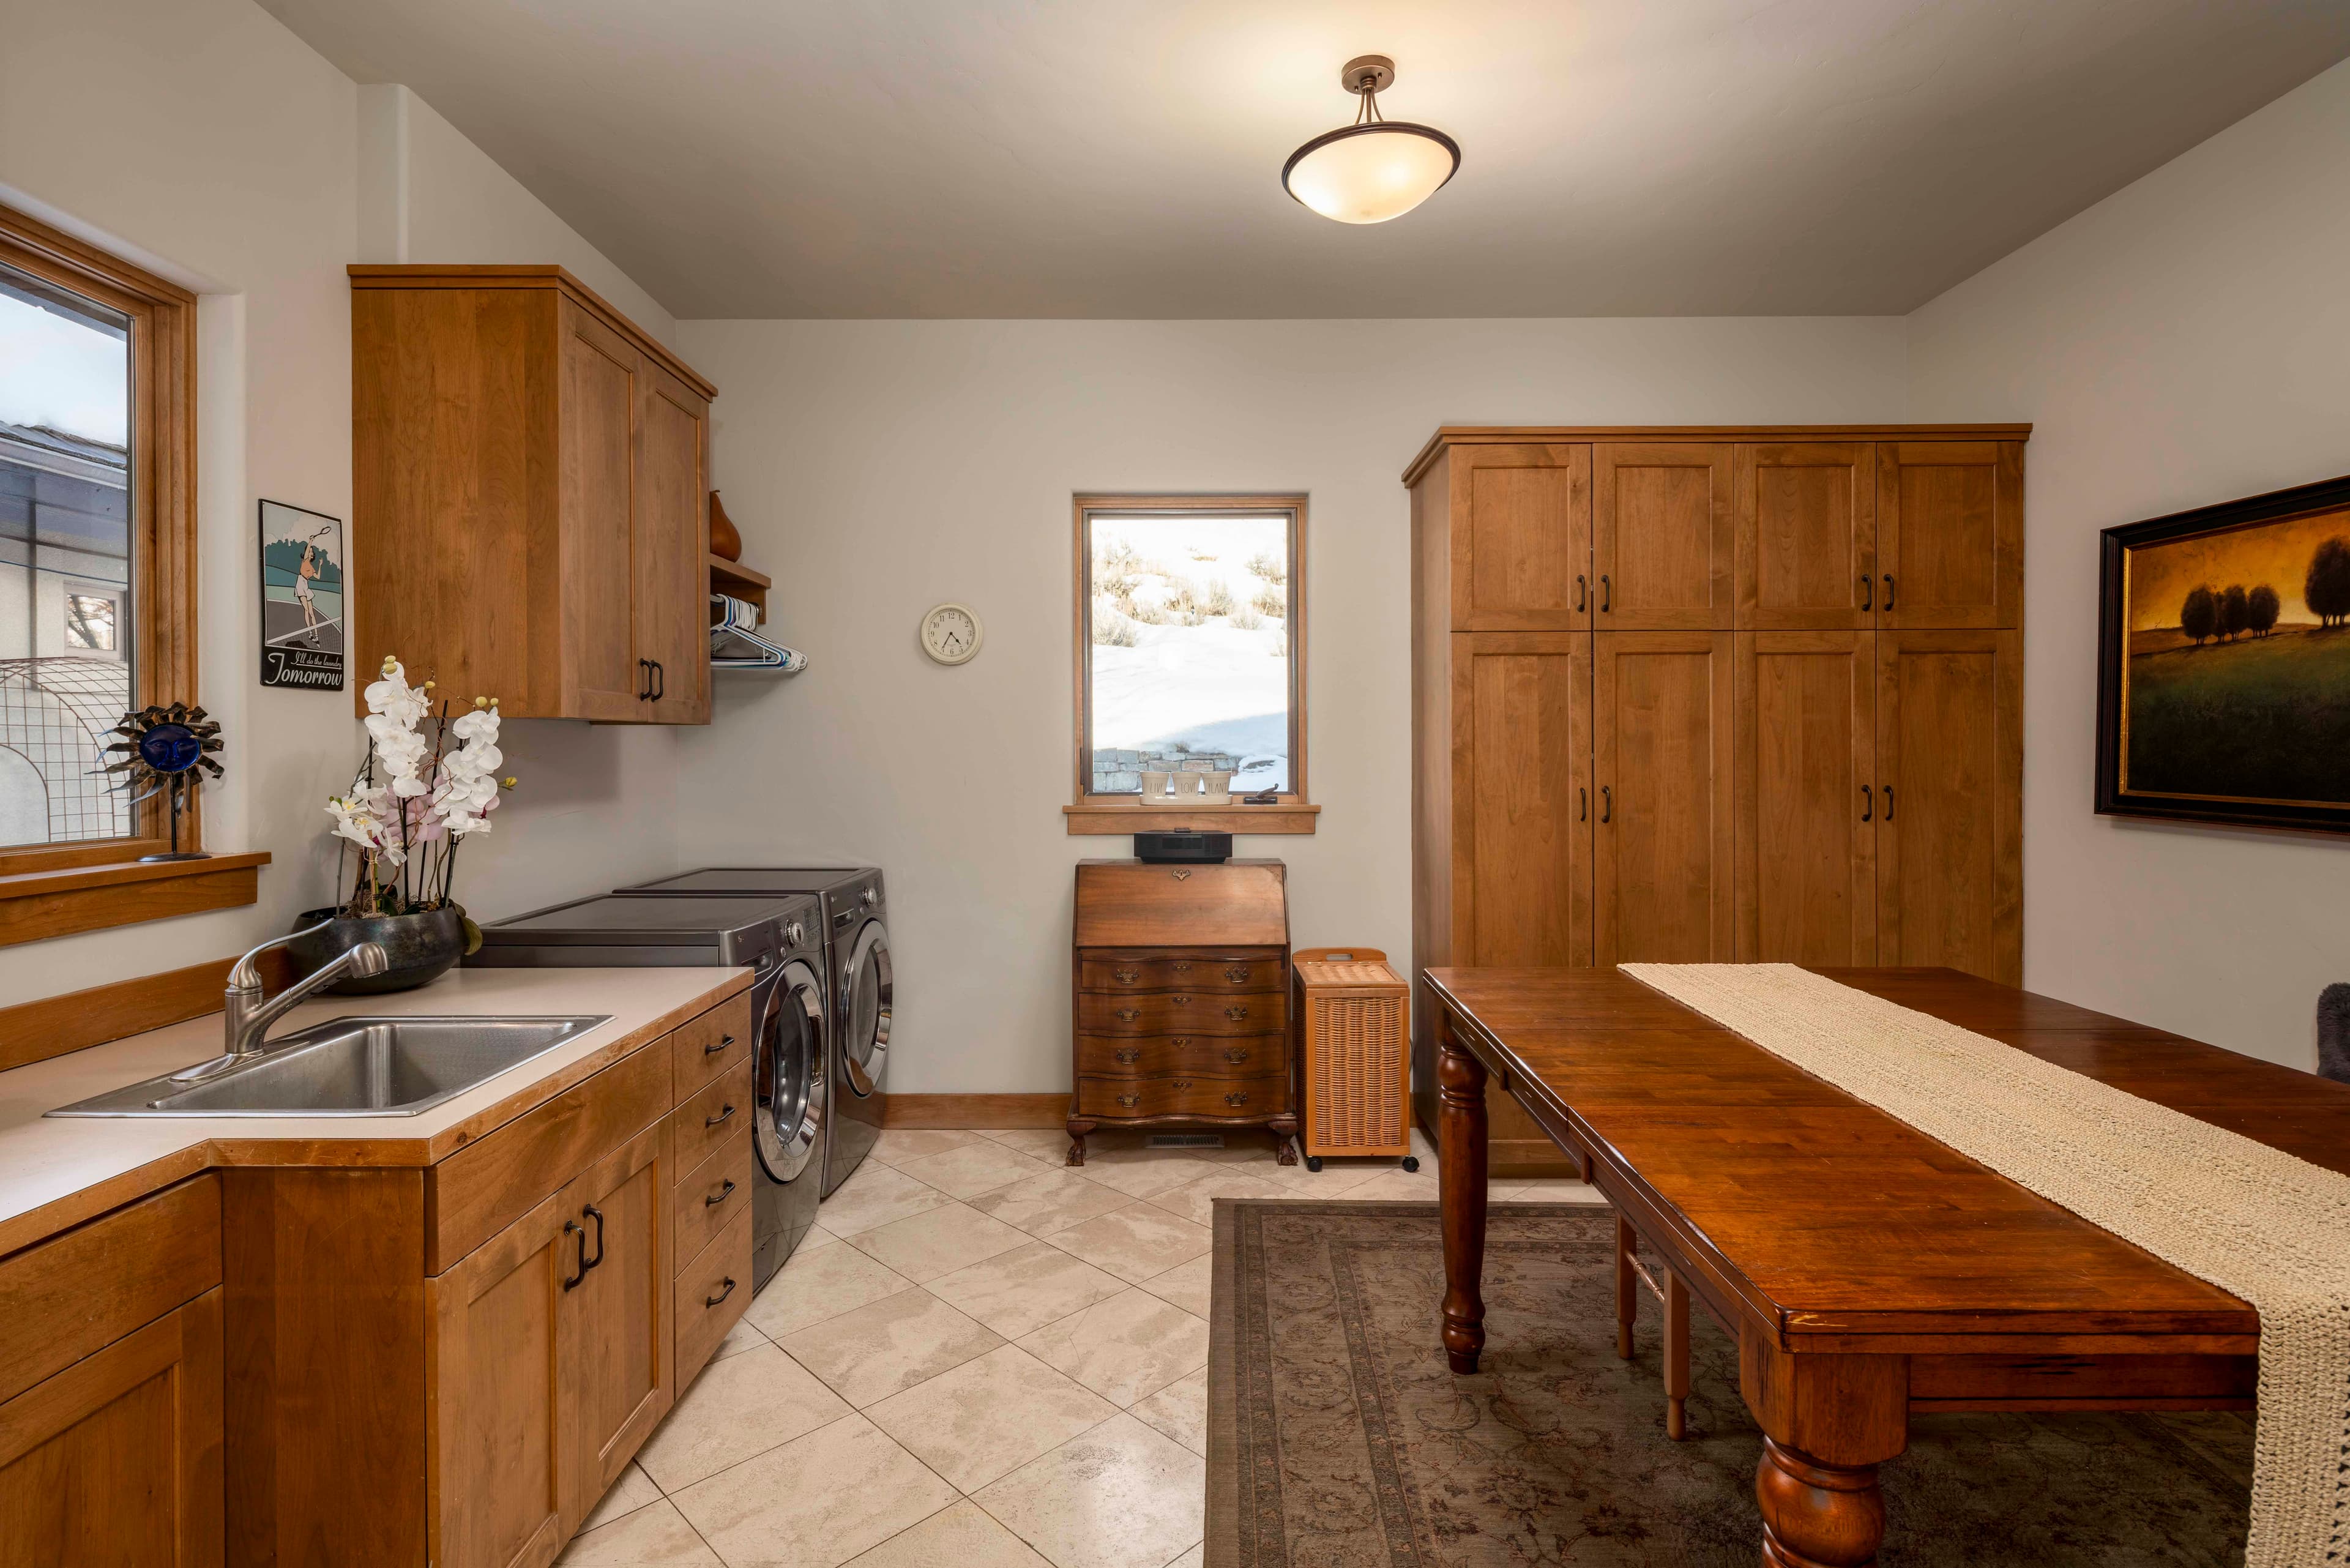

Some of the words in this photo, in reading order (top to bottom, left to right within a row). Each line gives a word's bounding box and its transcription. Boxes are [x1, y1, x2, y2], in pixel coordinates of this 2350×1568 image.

[264, 652, 342, 685] Tomorrow
[291, 651, 307, 665] I'll
[307, 654, 313, 664] do
[323, 655, 342, 669] laundry
[1181, 782, 1196, 794] LOVE
